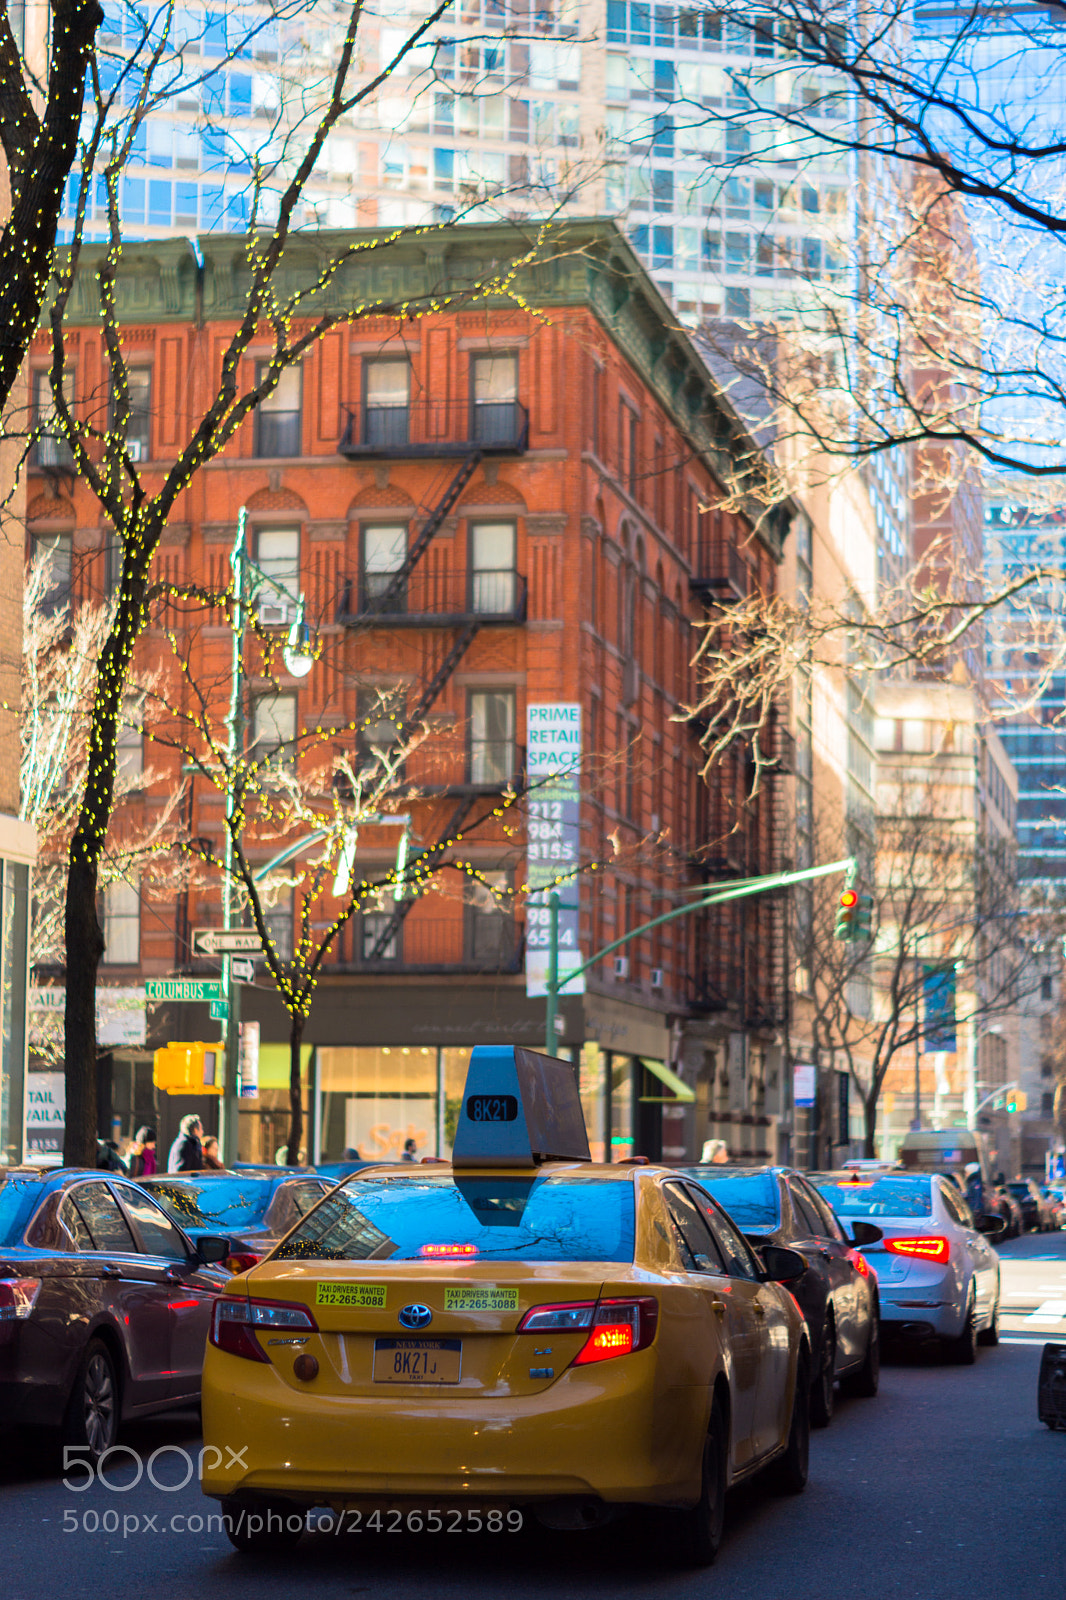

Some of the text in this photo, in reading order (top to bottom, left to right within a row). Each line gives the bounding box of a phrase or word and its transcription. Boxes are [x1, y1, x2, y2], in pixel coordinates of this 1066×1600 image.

[529, 708, 578, 721] PRIME
[529, 730, 579, 743] RETAIL
[528, 752, 579, 766] SPACE
[528, 802, 563, 819] 212
[527, 908, 562, 926] 98
[204, 938, 257, 948] ONE WAY
[527, 928, 574, 946] 654
[148, 982, 204, 999] COLUMBUS
[474, 1100, 507, 1121] 8K21
[319, 1285, 385, 1296] TAXI DRIVERS WANTED
[447, 1290, 517, 1299] TAXI DRIVERS WANTED
[318, 1294, 384, 1306] 212-265-3088
[447, 1300, 516, 1309] 212-265-3088
[418, 1341, 441, 1349] YORK
